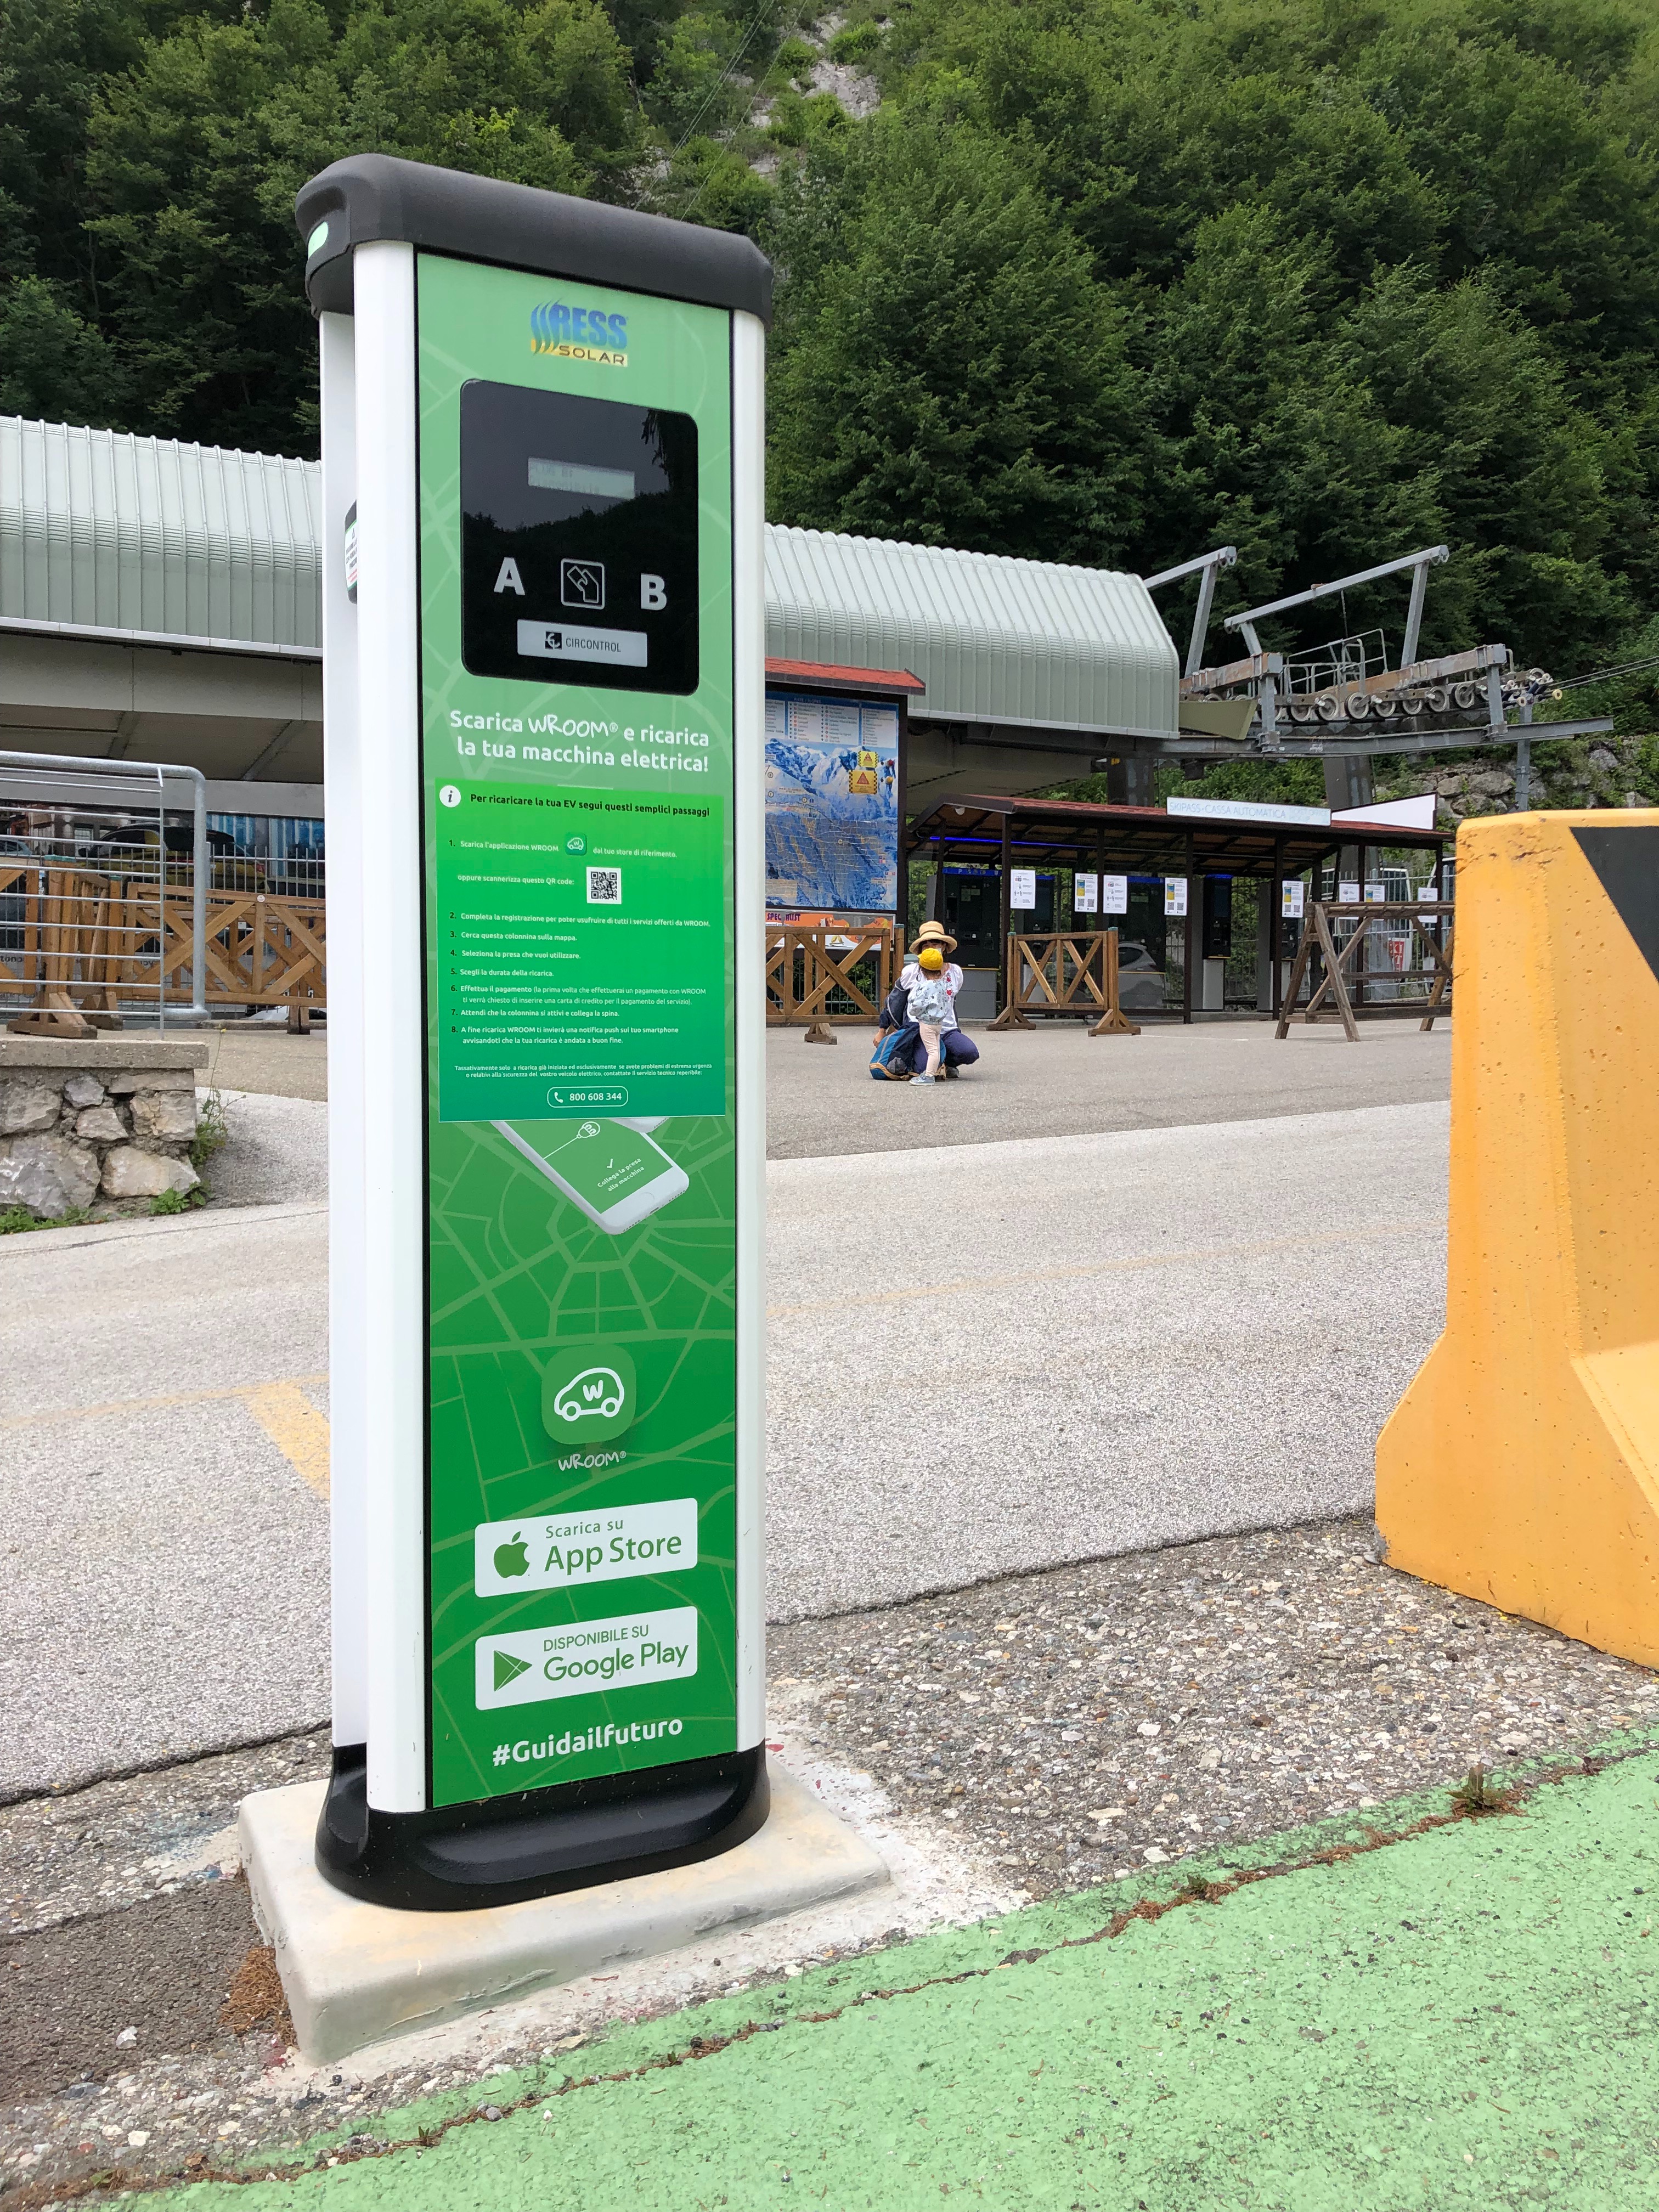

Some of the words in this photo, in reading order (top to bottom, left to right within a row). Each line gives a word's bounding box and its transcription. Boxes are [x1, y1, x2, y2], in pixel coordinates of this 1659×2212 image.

[549, 301, 628, 350] RESS
[558, 345, 625, 365] SOLAR
[493, 557, 525, 596] A
[640, 573, 667, 610] B
[565, 636, 622, 653] CIRCONTROL
[450, 709, 523, 732] Scarica
[623, 727, 635, 741] e
[641, 724, 709, 746] ricarica
[458, 736, 475, 755] la
[482, 740, 516, 758] tua
[522, 745, 614, 765] macchina
[620, 749, 708, 772] elettrica!
[470, 794, 487, 802] Per
[489, 795, 533, 805] ricaricare
[535, 797, 544, 806] la
[546, 799, 561, 807] tua
[578, 802, 602, 810] segui
[605, 803, 632, 811] questi
[635, 805, 670, 814] semplici
[673, 808, 709, 817] passaggi
[1233, 806, 1286, 819] AUTOMATICA
[767, 912, 801, 922] SPECALIST
[597, 1172, 619, 1187] Collega
[625, 1158, 641, 1171] presa
[608, 1183, 619, 1192] alla
[618, 1166, 645, 1184] macchina
[582, 1380, 603, 1402] W
[545, 1521, 601, 1539] Scarica
[607, 1519, 624, 1531] su
[544, 1545, 603, 1576] App
[609, 1536, 682, 1563] Store
[543, 1627, 628, 1652] DISPONIBILE
[631, 1624, 649, 1638] SU
[543, 1647, 635, 1681] Google
[641, 1641, 689, 1668] Play
[492, 1719, 683, 1767] #Guidailfuturo
